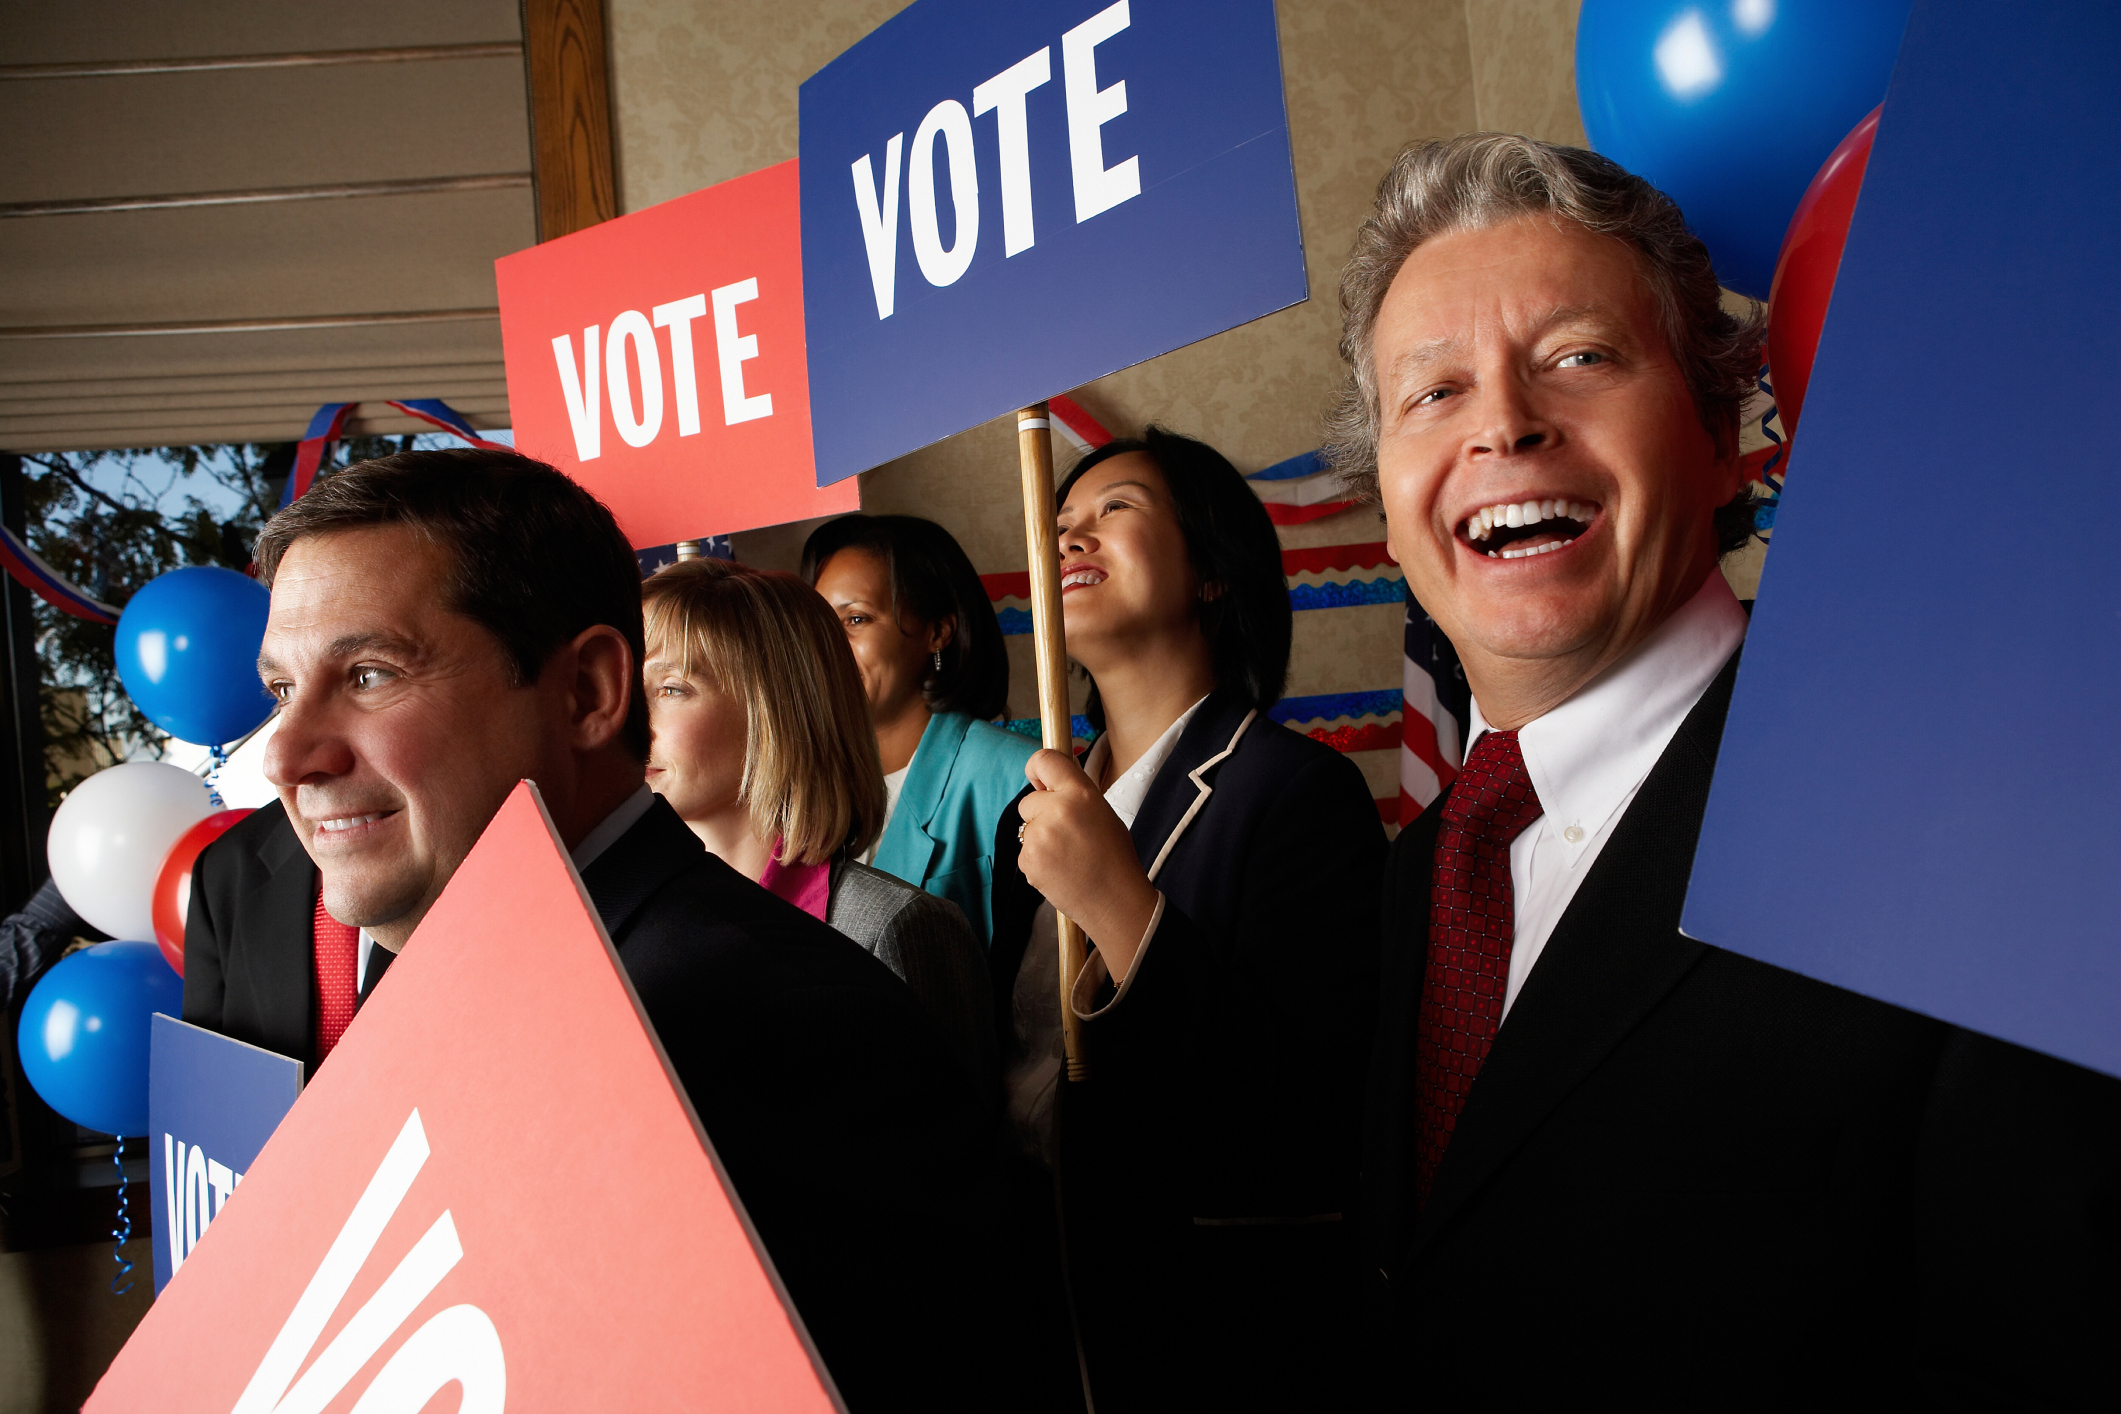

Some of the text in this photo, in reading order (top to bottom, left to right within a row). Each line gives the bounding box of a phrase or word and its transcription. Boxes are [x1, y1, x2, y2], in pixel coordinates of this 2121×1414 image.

[851, 0, 1142, 320] VOTE
[552, 277, 774, 462] VOTE
[164, 1132, 244, 1278] VOT
